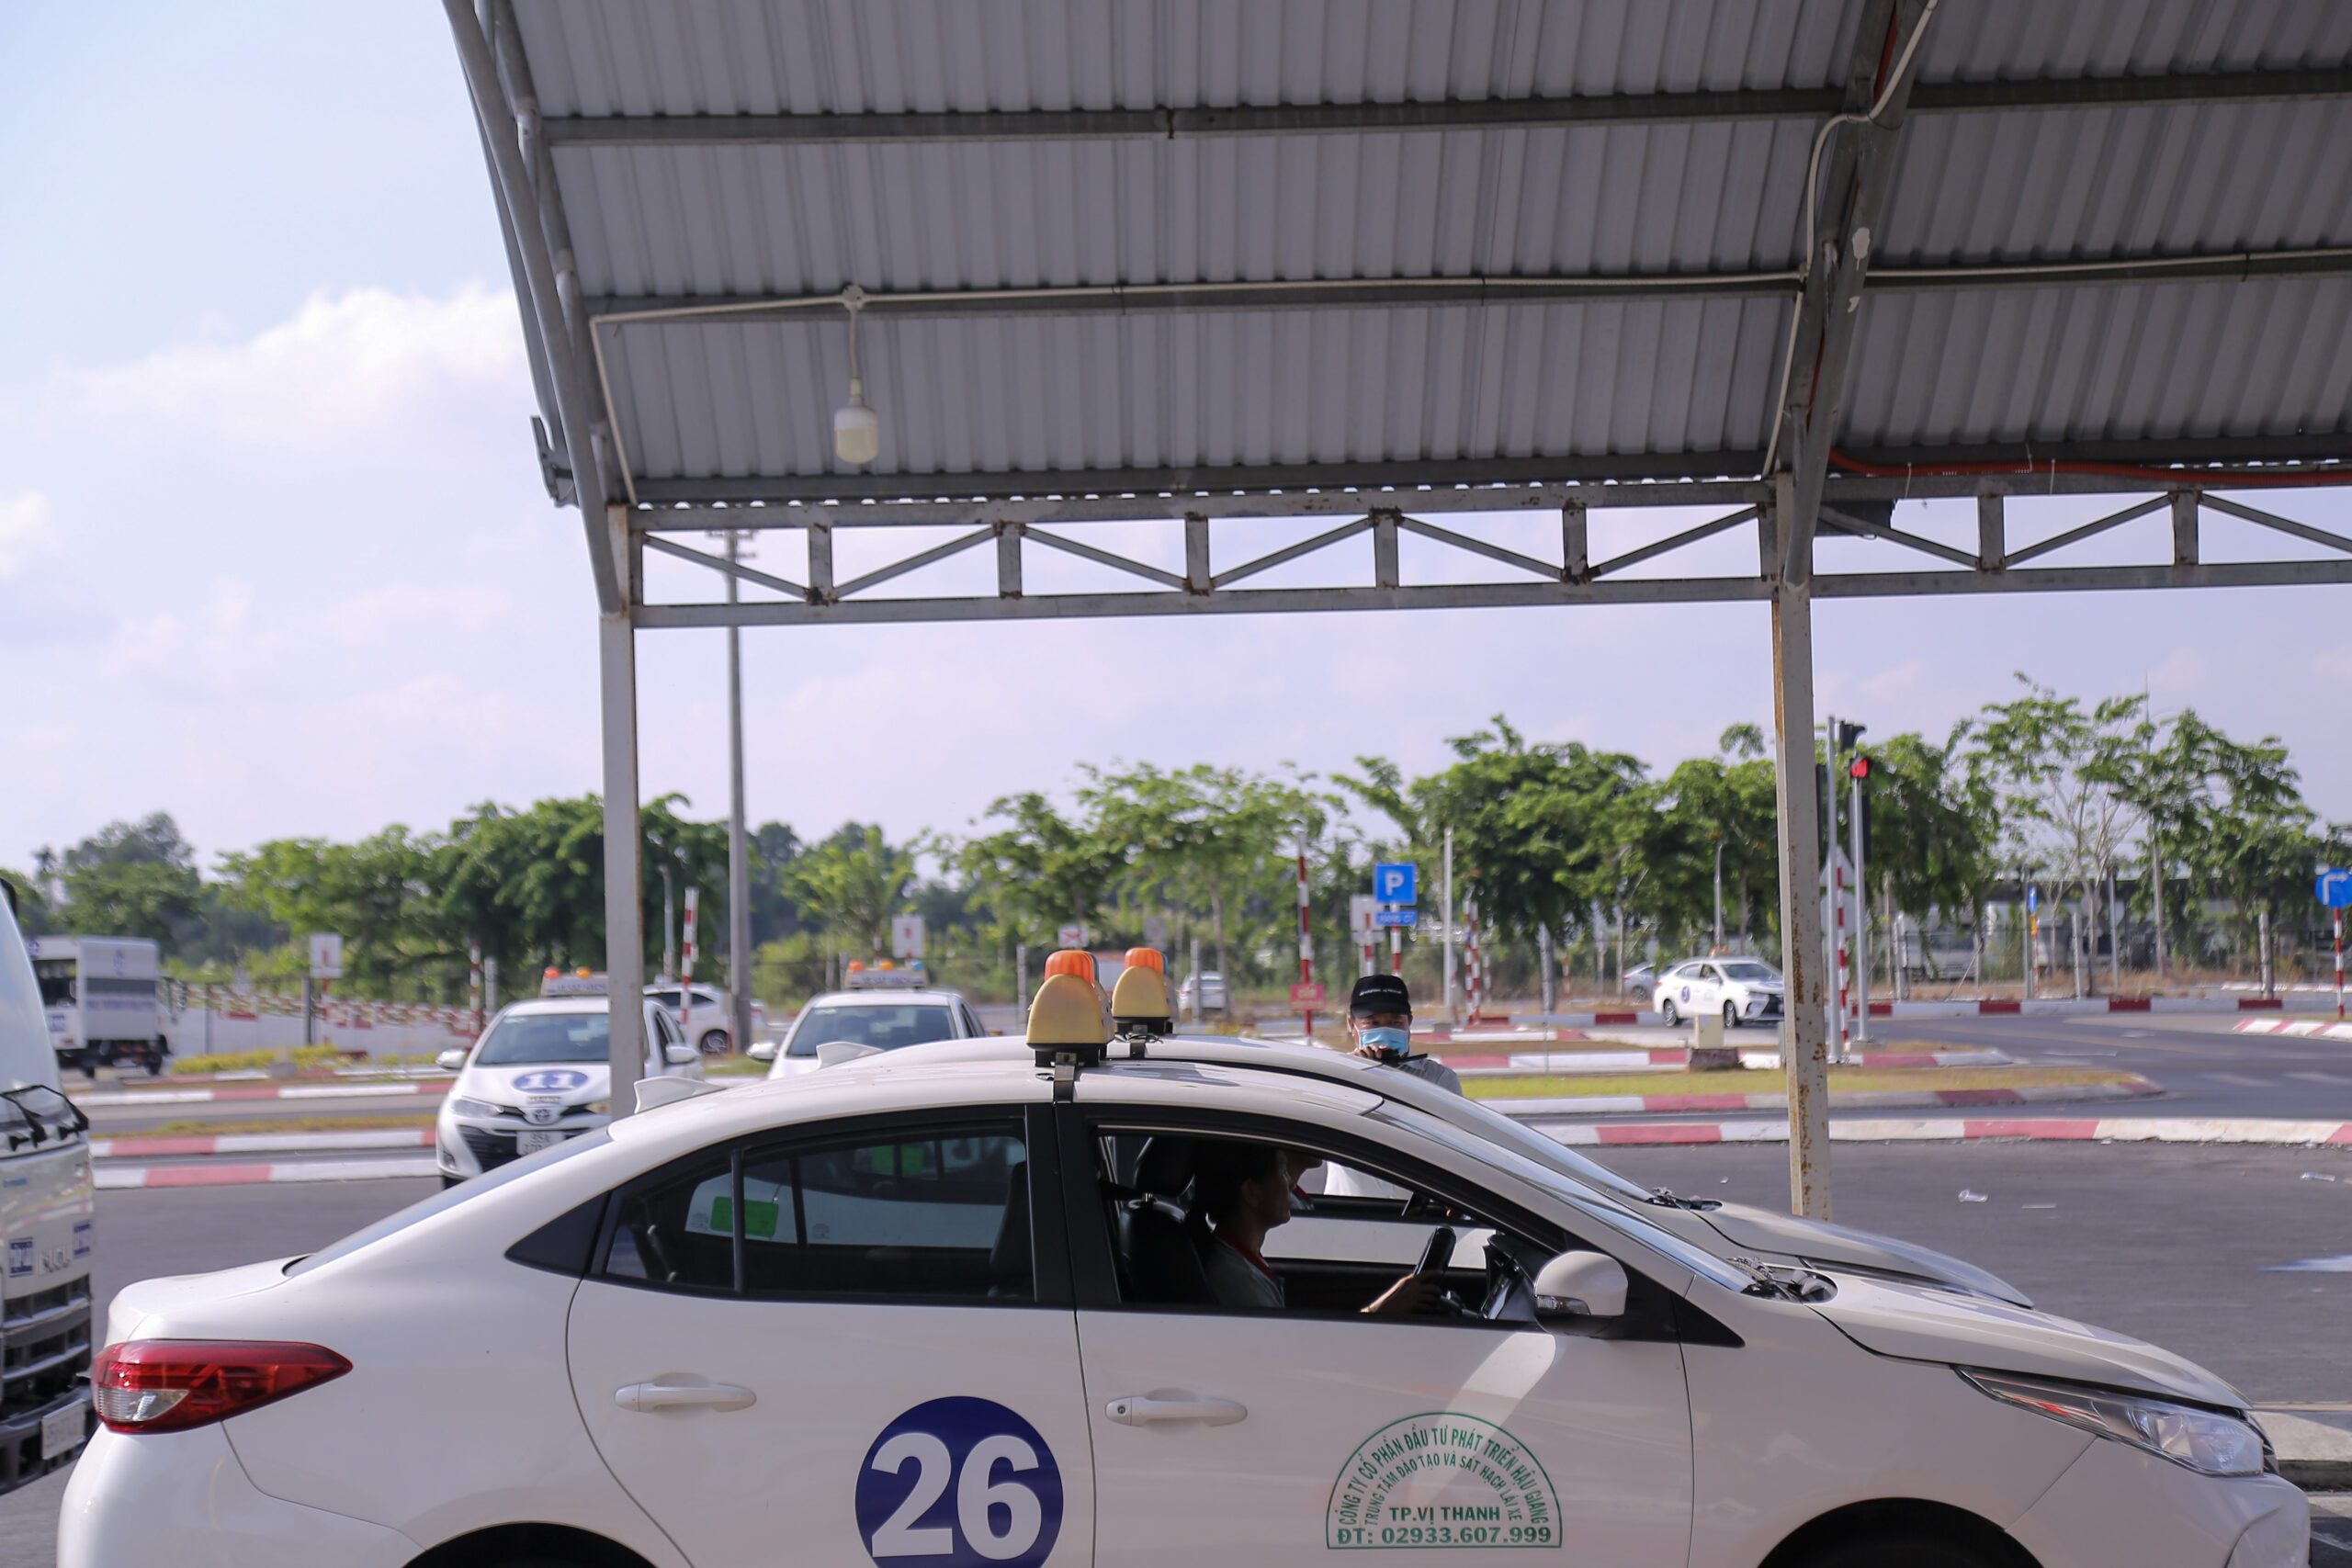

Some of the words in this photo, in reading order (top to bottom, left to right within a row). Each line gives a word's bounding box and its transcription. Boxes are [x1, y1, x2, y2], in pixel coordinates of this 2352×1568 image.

[1385, 871, 1404, 896] P
[520, 1074, 576, 1089] 11
[1404, 1424, 1429, 1450] ĐẦU
[1431, 1425, 1448, 1446] TƯ
[1452, 1428, 1483, 1451] PHÁT
[1371, 1436, 1405, 1468] PHẦN
[1418, 1453, 1440, 1471] TẠO
[1443, 1450, 1456, 1467] VÀ
[1483, 1438, 1520, 1472] TRIỂN
[1358, 1453, 1378, 1480] CỔ
[1396, 1459, 1419, 1478] ĐÀO
[1460, 1455, 1481, 1473] SÁT
[1347, 1476, 1367, 1495] TY
[1377, 1472, 1399, 1494] TÂM
[1479, 1465, 1507, 1492] HẠCH
[1510, 1465, 1537, 1491] HẬU
[871, 1432, 1042, 1561] 26
[1499, 1489, 1520, 1507] LÁI
[1524, 1490, 1549, 1525] GIANG
[1335, 1495, 1361, 1525] CÔNG
[1364, 1493, 1385, 1525] TRUNG
[1389, 1506, 1434, 1525] TP.VỊ
[1441, 1506, 1500, 1521] THANH
[1507, 1507, 1522, 1522] XE
[1338, 1528, 1373, 1545] ĐT:
[1381, 1527, 1552, 1544] 02933.607.999
